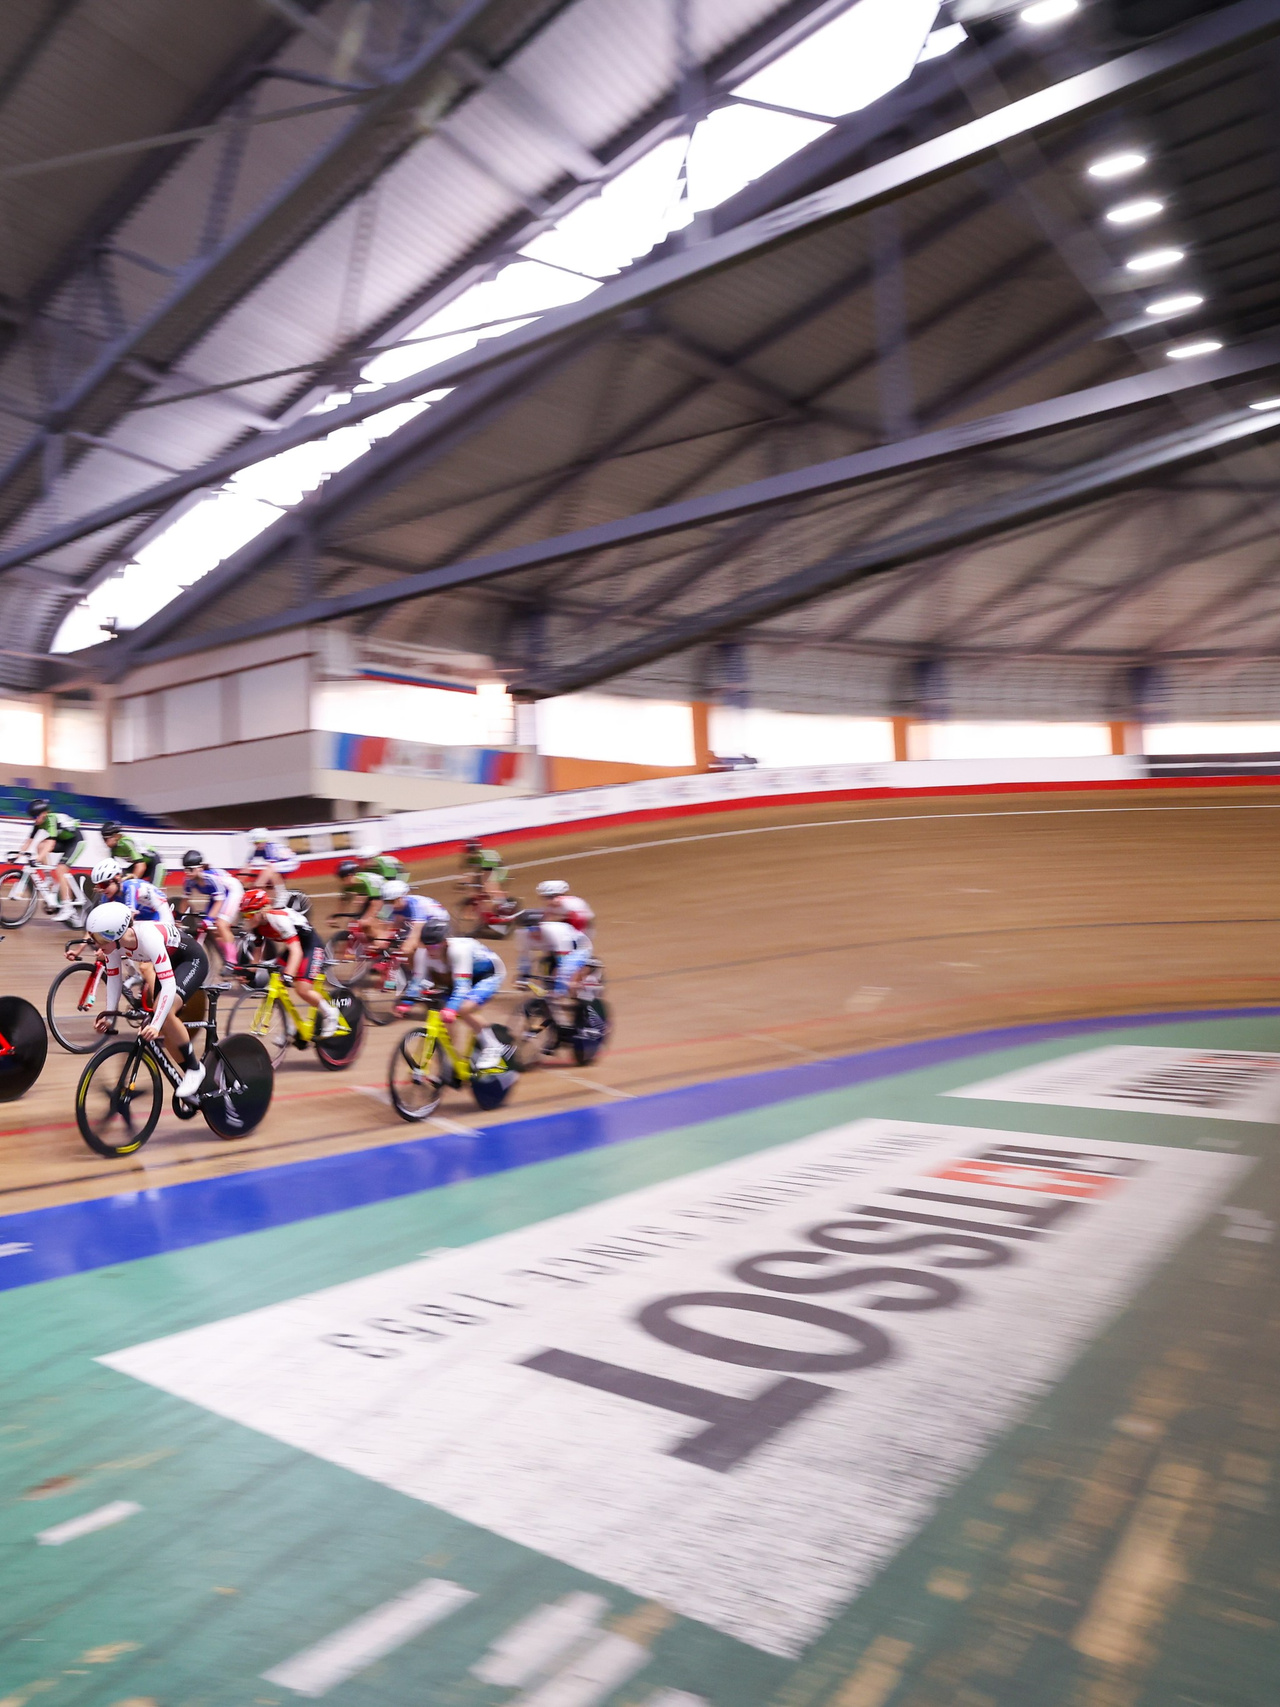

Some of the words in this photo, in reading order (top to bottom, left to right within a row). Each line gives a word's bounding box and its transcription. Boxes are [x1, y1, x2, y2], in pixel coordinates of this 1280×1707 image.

[116, 914, 131, 936] KASK
[512, 1224, 704, 1290] SINCE
[319, 1291, 523, 1361] 1853
[519, 1185, 1101, 1472] TISSOT
